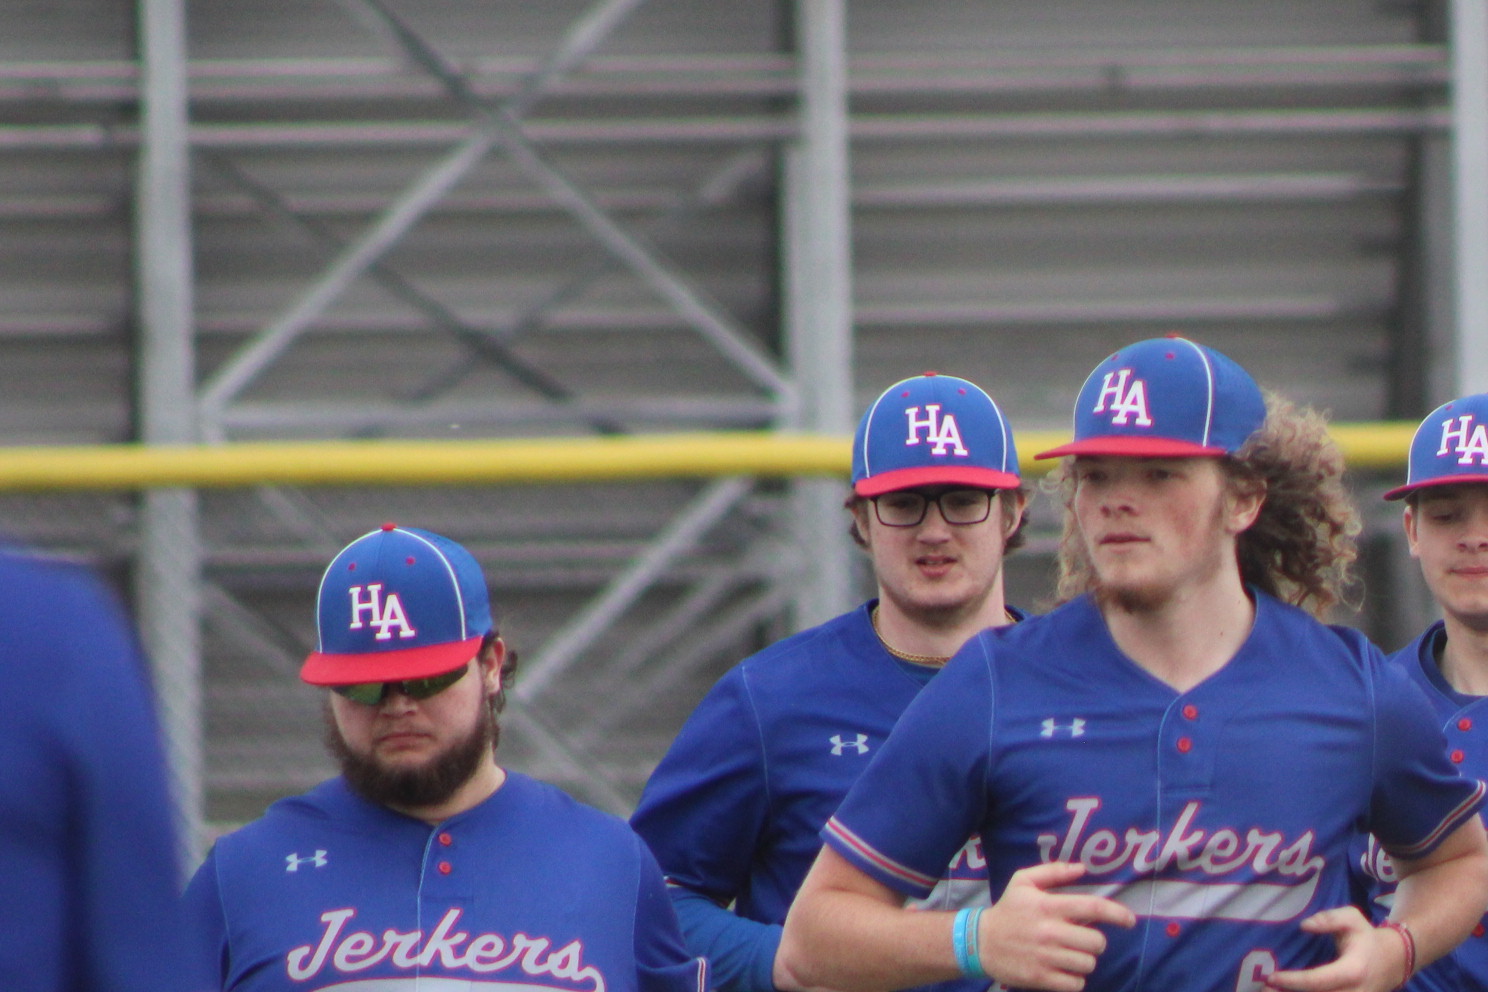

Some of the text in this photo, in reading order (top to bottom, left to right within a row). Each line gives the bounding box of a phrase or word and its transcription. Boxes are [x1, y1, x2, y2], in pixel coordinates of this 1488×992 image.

[1092, 368, 1153, 427] HA
[904, 404, 968, 457] HA
[348, 583, 416, 640] HA
[1036, 797, 1320, 876] Jerkers
[286, 907, 592, 982] Jerkers
